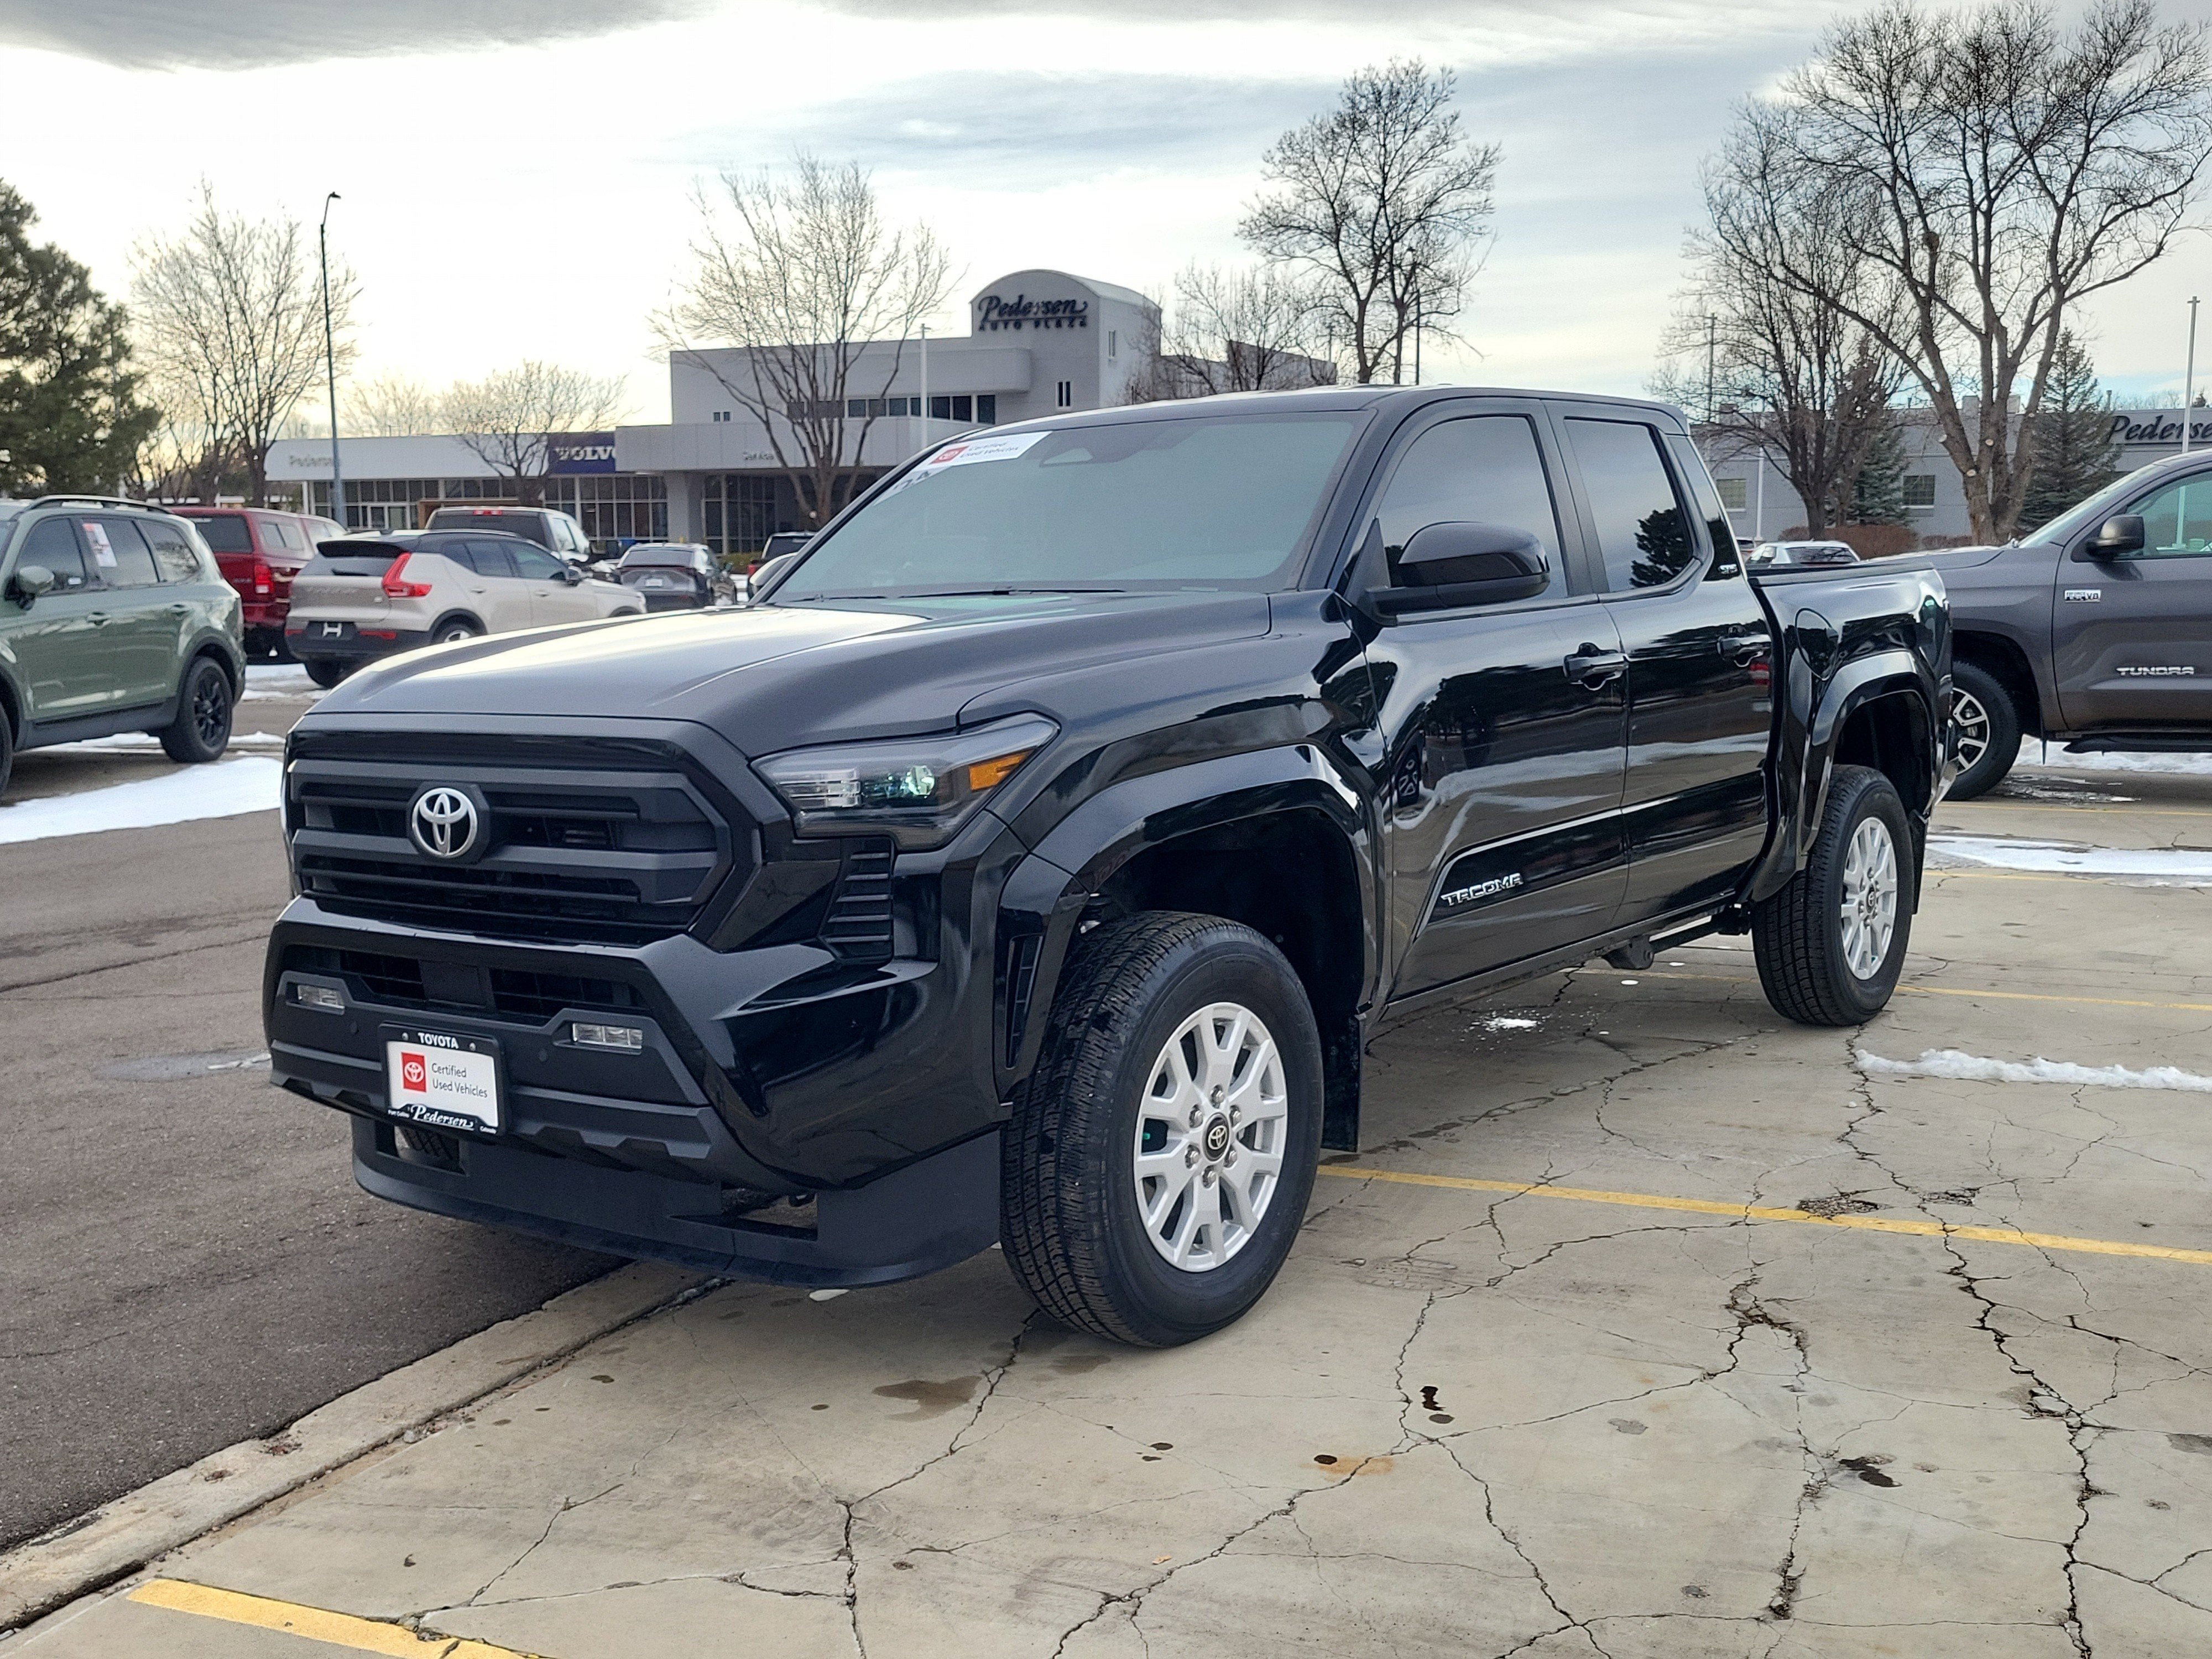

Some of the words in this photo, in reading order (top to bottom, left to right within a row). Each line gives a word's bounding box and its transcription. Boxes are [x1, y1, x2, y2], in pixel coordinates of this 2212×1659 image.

[978, 294, 1088, 321] Pedersen
[979, 319, 1022, 331] AUTO
[1034, 316, 1087, 328] PLAZA
[2116, 666, 2194, 676] TUNDRA
[1440, 872, 1524, 906] TACOMA
[418, 1032, 459, 1050] TOYOTA
[431, 1062, 467, 1078] Certified
[432, 1078, 452, 1092] Used
[454, 1082, 488, 1098] Vehicles
[410, 1104, 474, 1131] Pedersen
